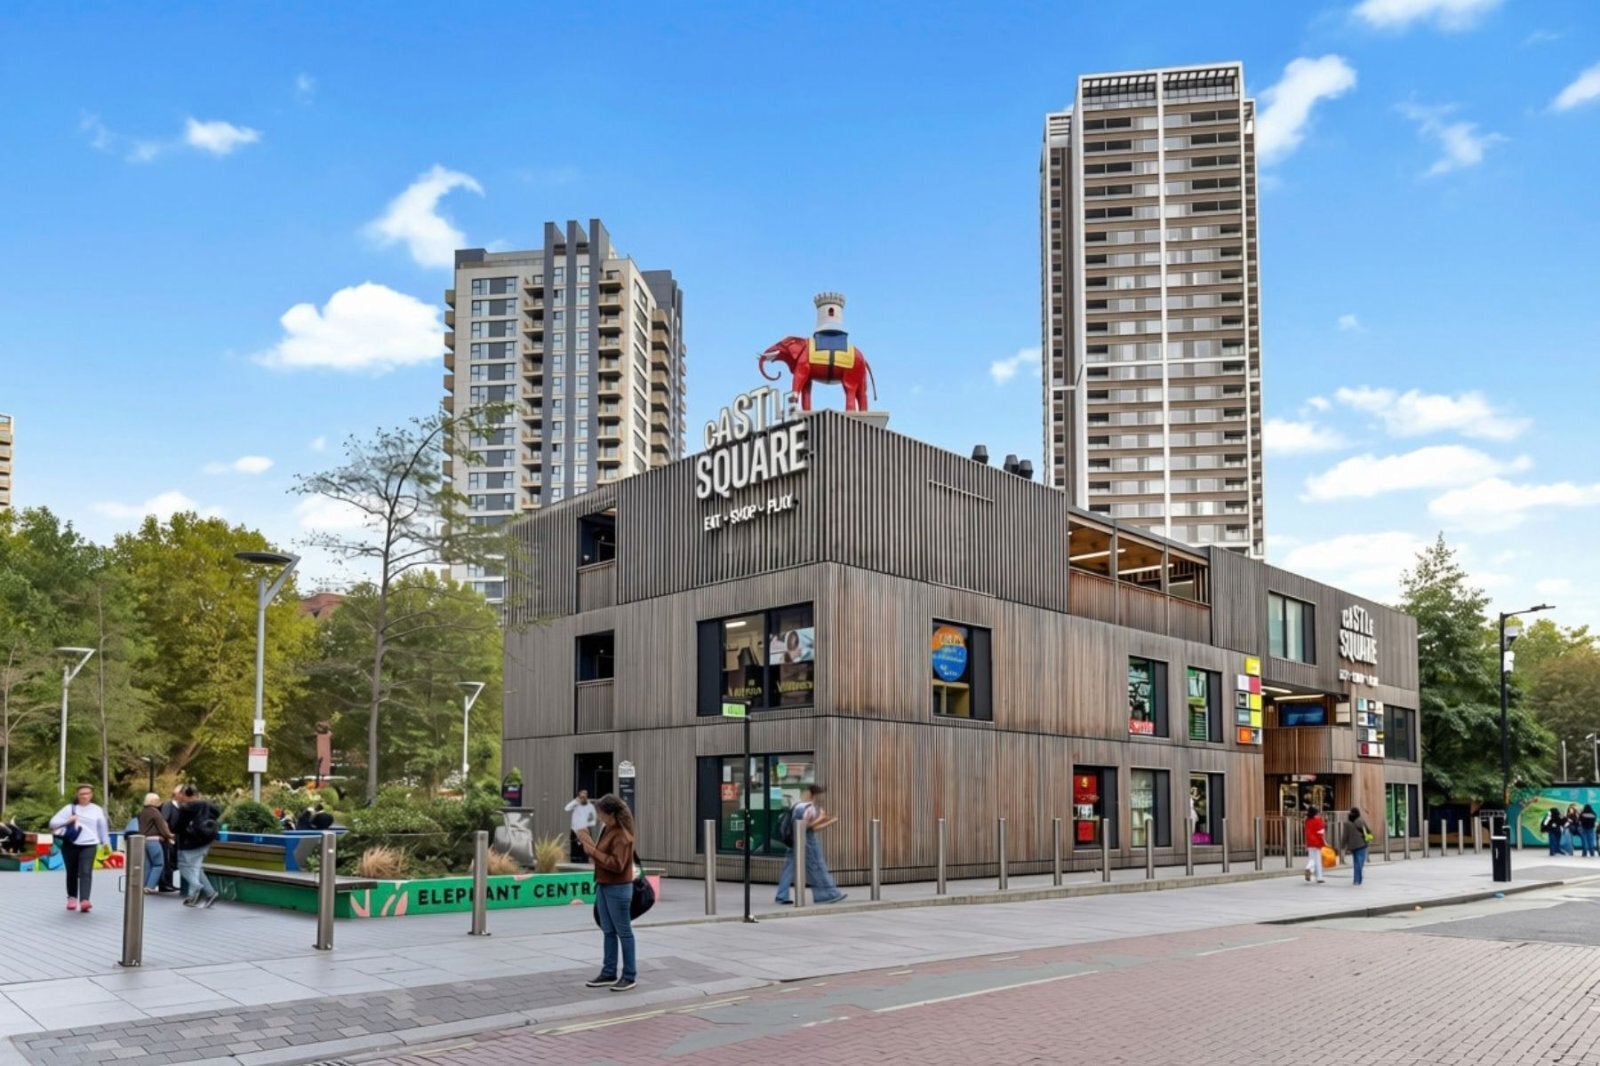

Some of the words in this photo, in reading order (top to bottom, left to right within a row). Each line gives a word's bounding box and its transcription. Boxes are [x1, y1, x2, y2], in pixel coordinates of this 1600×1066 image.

[704, 385, 800, 450] CASTLE
[696, 422, 808, 499] SQUARE
[704, 514, 721, 531] EAT
[730, 504, 757, 524] SHOP
[767, 493, 793, 514] PLAY
[1341, 604, 1375, 637] CASTLE
[1339, 628, 1378, 665] SQUARE
[533, 880, 596, 898] CENTR
